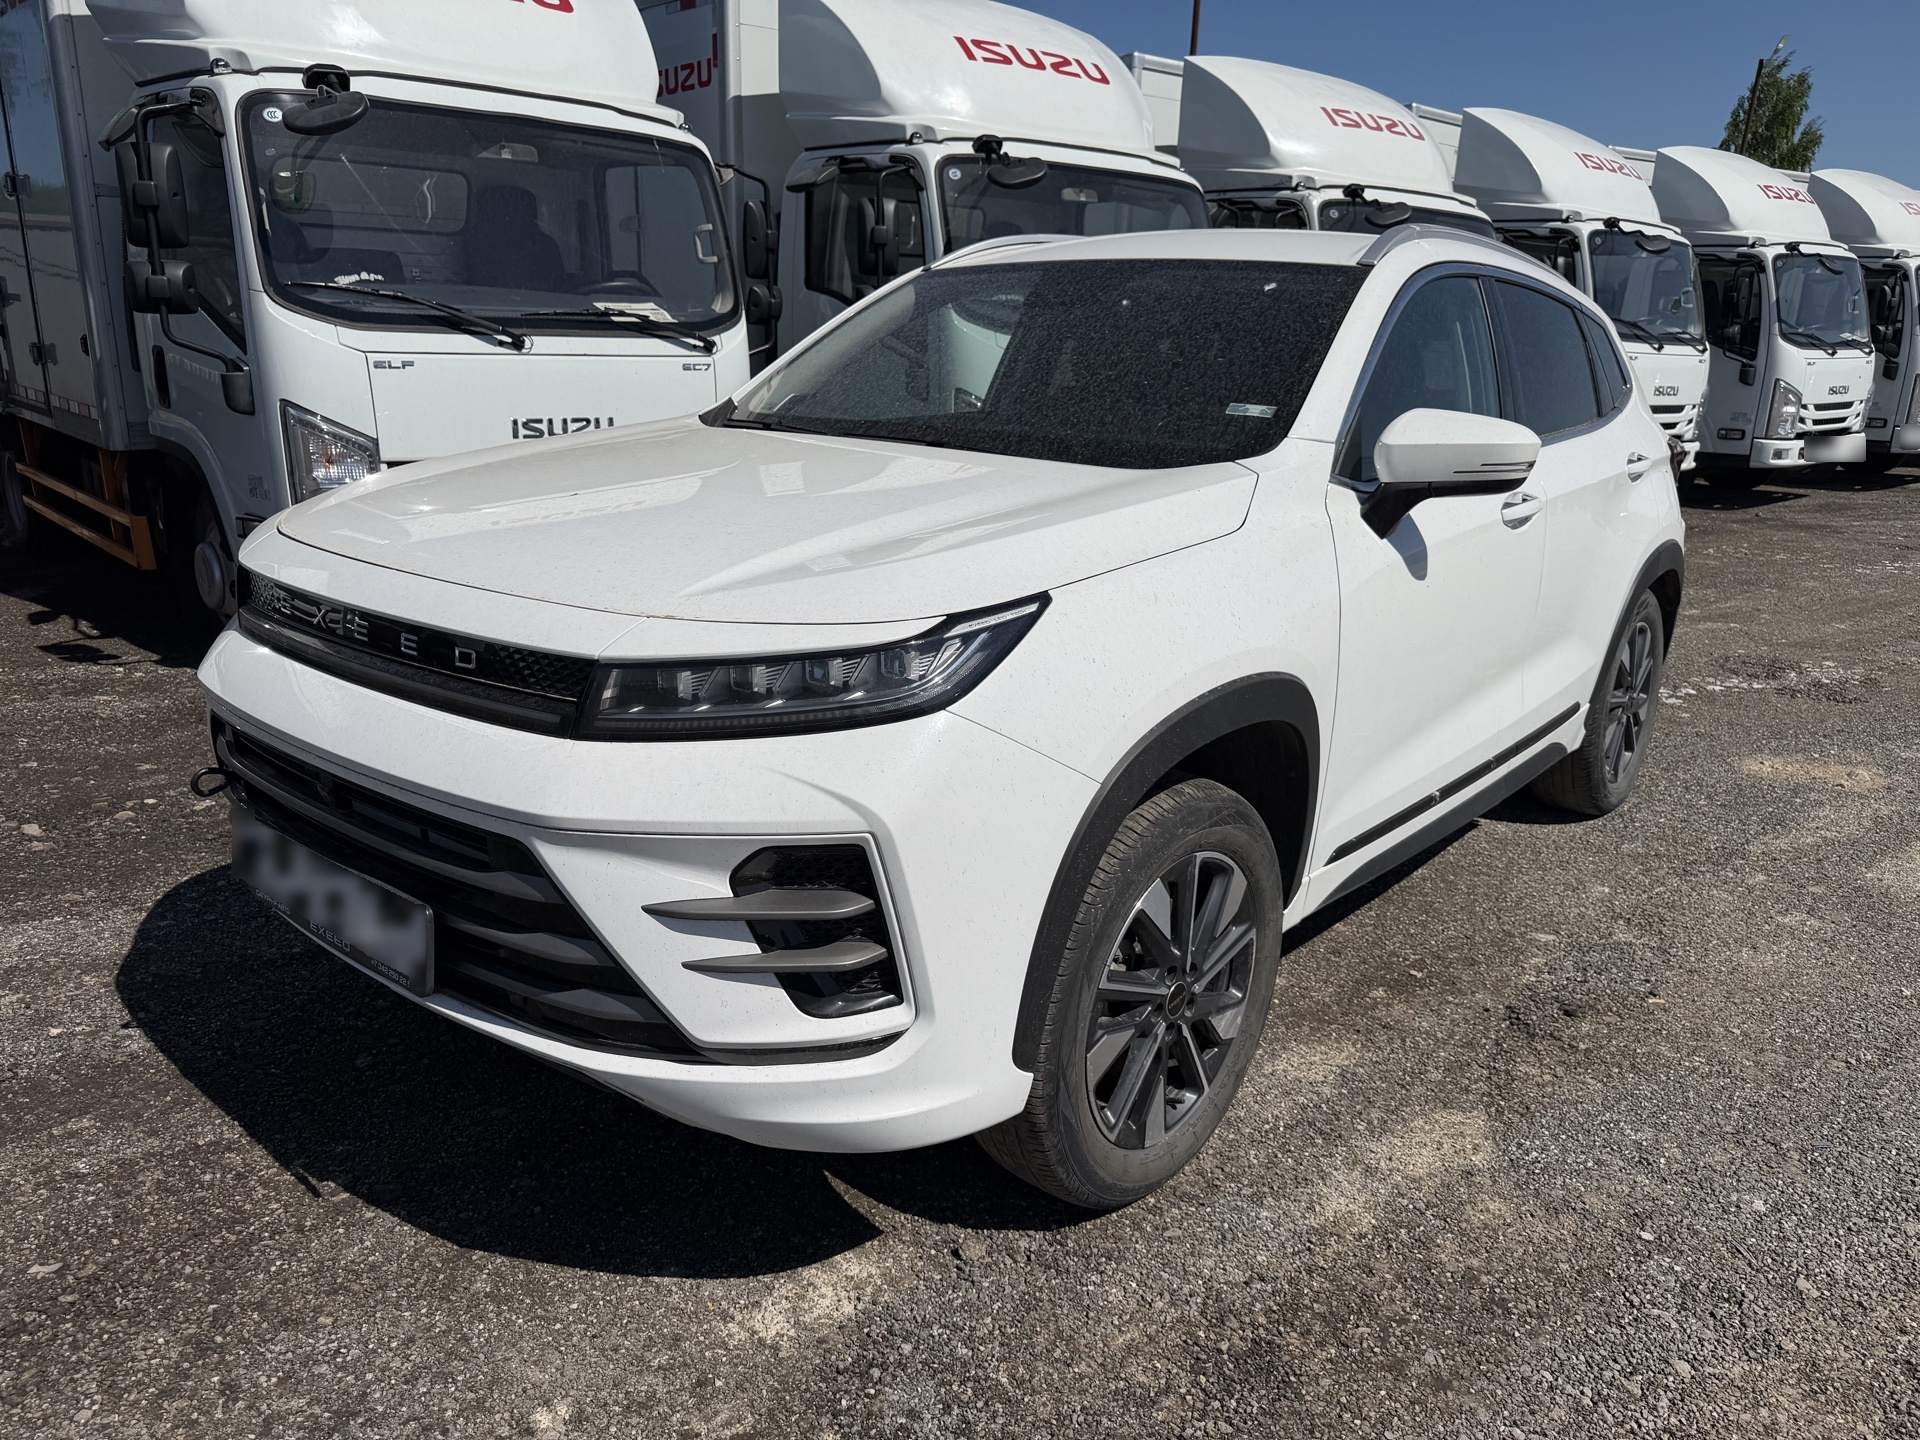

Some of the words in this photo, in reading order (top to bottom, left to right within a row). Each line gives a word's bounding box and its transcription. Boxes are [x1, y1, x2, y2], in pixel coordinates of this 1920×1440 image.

[953, 36, 1110, 85] ISUZU
[1320, 106, 1425, 141] ISUZU
[1573, 151, 1643, 181] ISUZU
[1756, 184, 1816, 205] ISUZU
[1898, 201, 1920, 216] IS
[682, 363, 711, 371] EC7
[1653, 385, 1679, 397] ISUZU
[1828, 385, 1850, 396] ISUZU
[310, 920, 350, 951] EXEED
